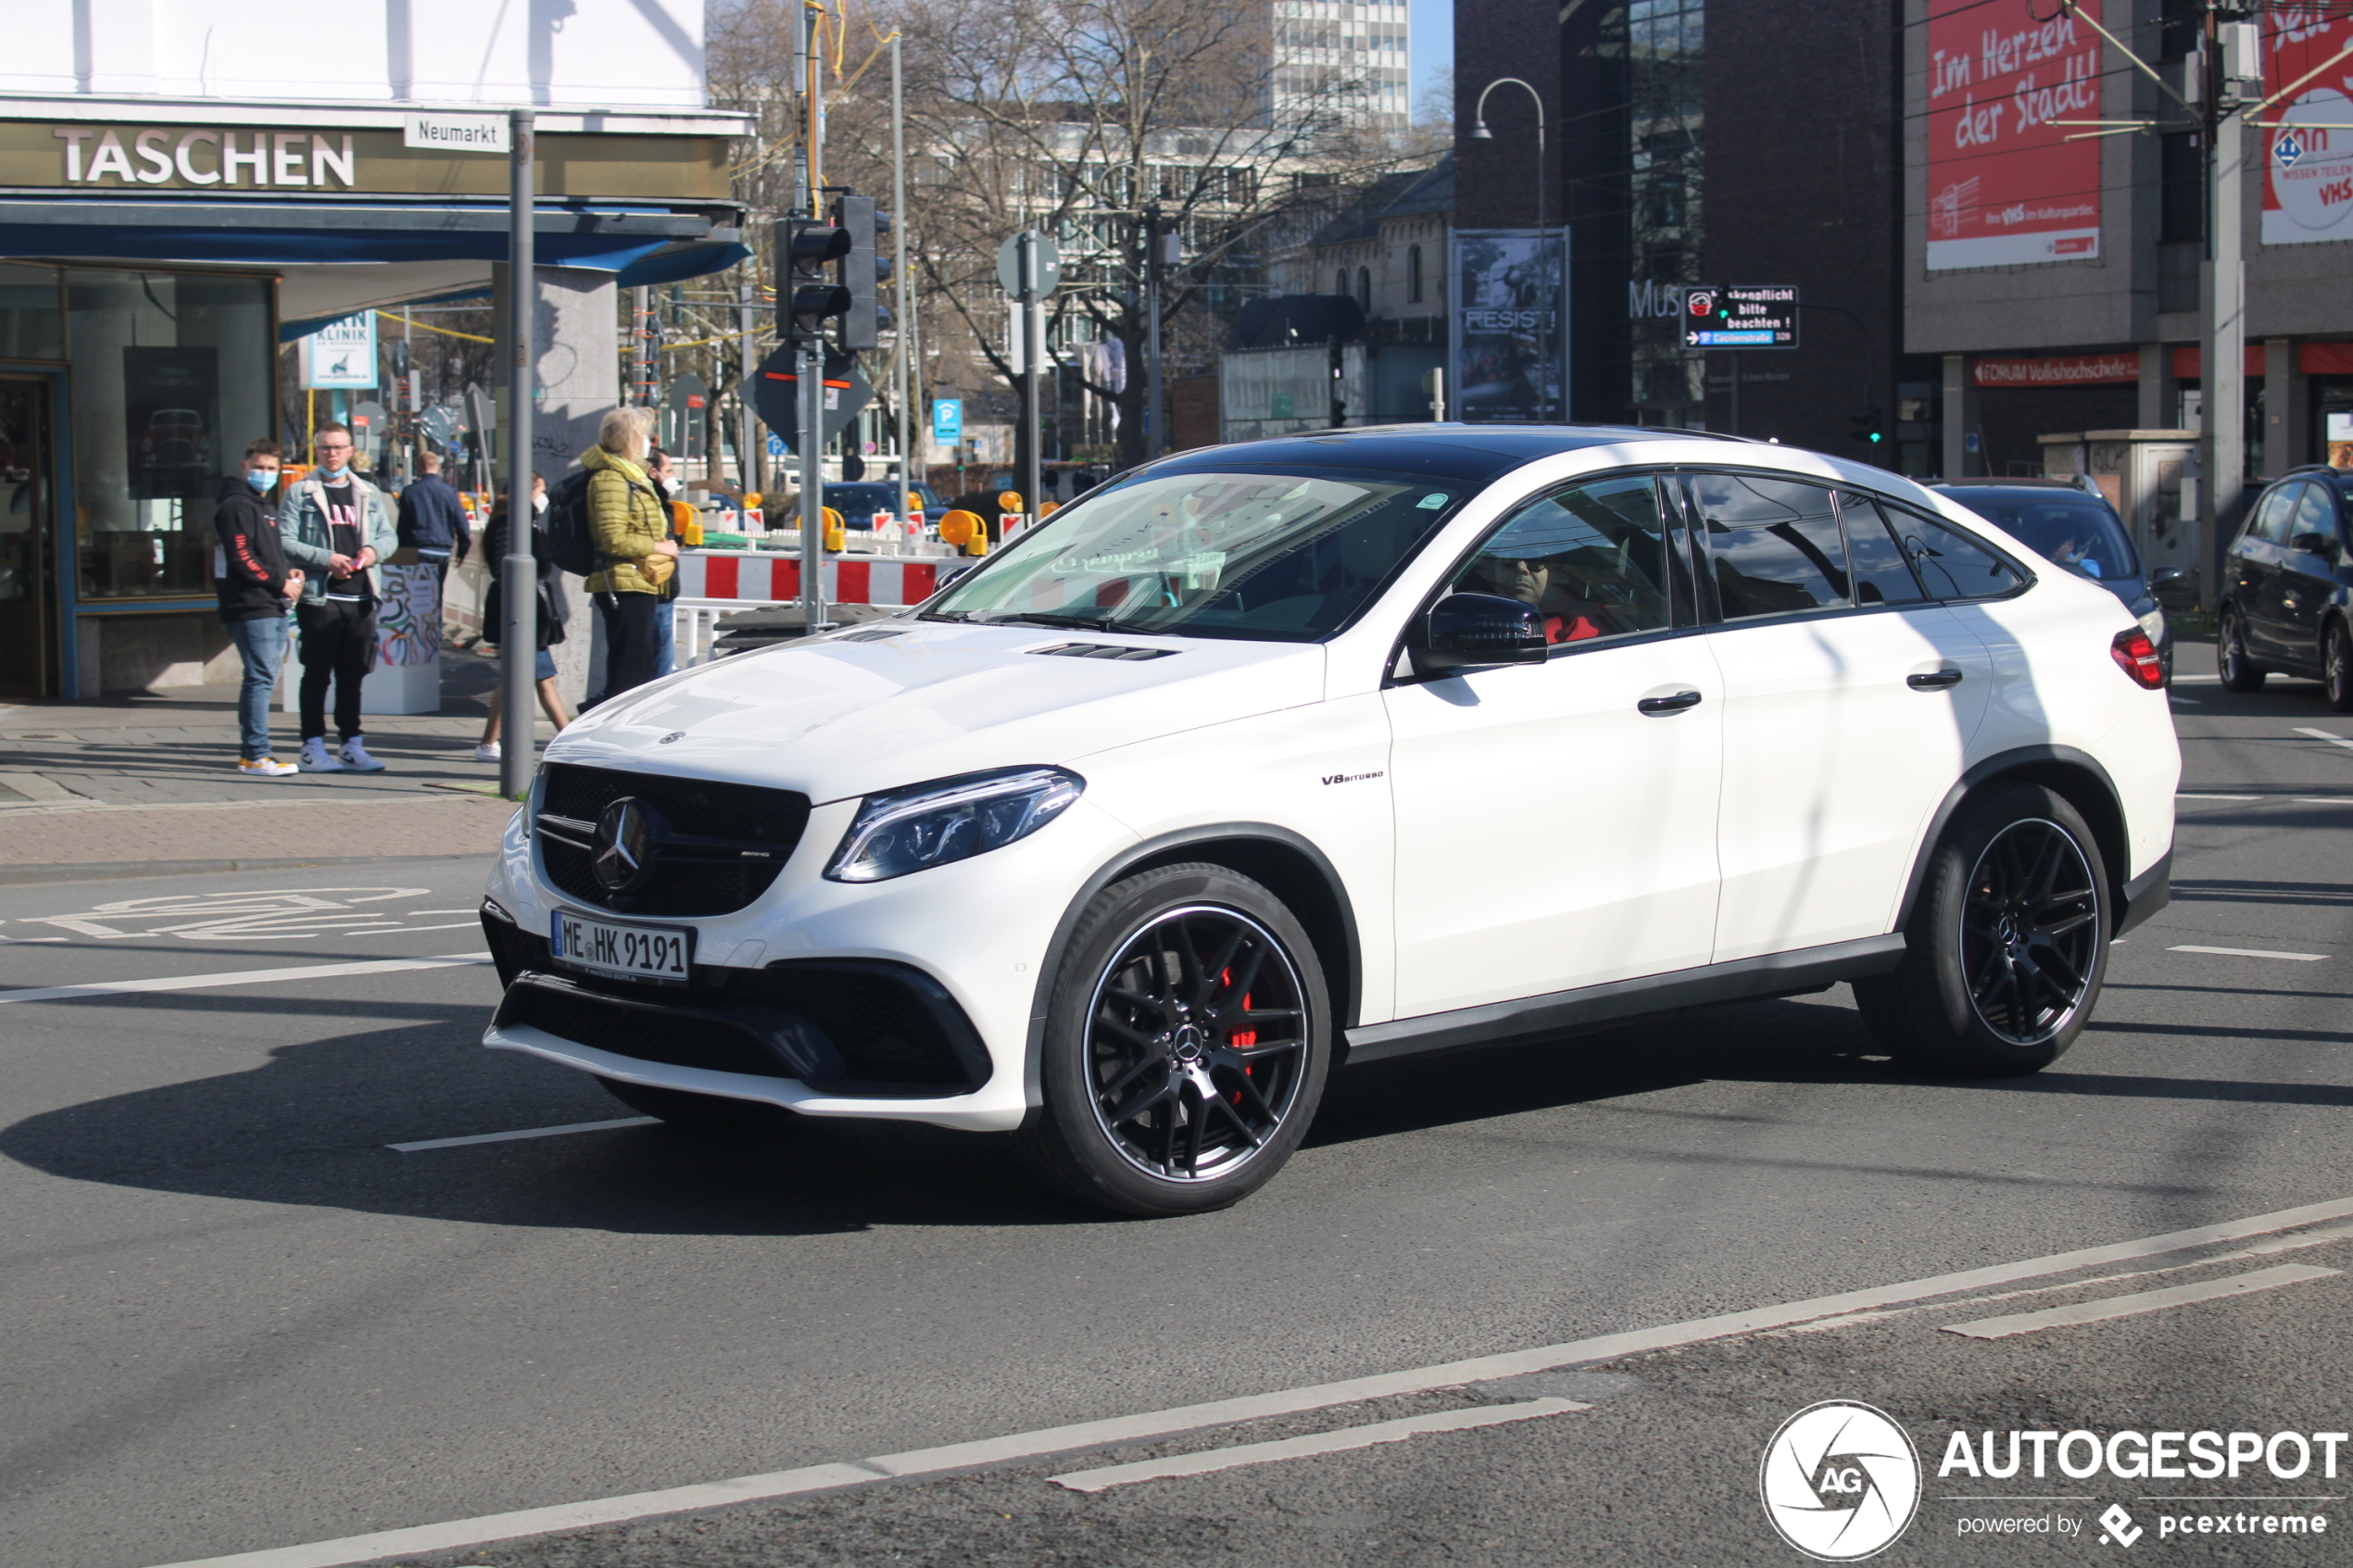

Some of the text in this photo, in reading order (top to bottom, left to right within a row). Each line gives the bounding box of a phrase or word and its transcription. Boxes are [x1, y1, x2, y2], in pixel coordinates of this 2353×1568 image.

[1931, 13, 2077, 98] Im Herzen
[1956, 47, 2095, 148] der Stadt!
[418, 119, 497, 144] Neumarkt
[54, 128, 354, 186] TASCHEN
[2283, 164, 2353, 180] WISSEN TEILEN
[2319, 177, 2353, 206] VHS
[2002, 204, 2025, 225] VHS
[1629, 279, 1680, 319] Mus
[1711, 289, 1794, 301] skenpflicht
[1738, 303, 1768, 315] bitte
[317, 329, 367, 340] KLINIK
[1727, 317, 1781, 329] beachten
[1984, 363, 2027, 382] FORUM
[2029, 358, 2125, 382] Volkshochschule
[941, 408, 953, 421] P
[563, 919, 684, 972] ME HK 9191
